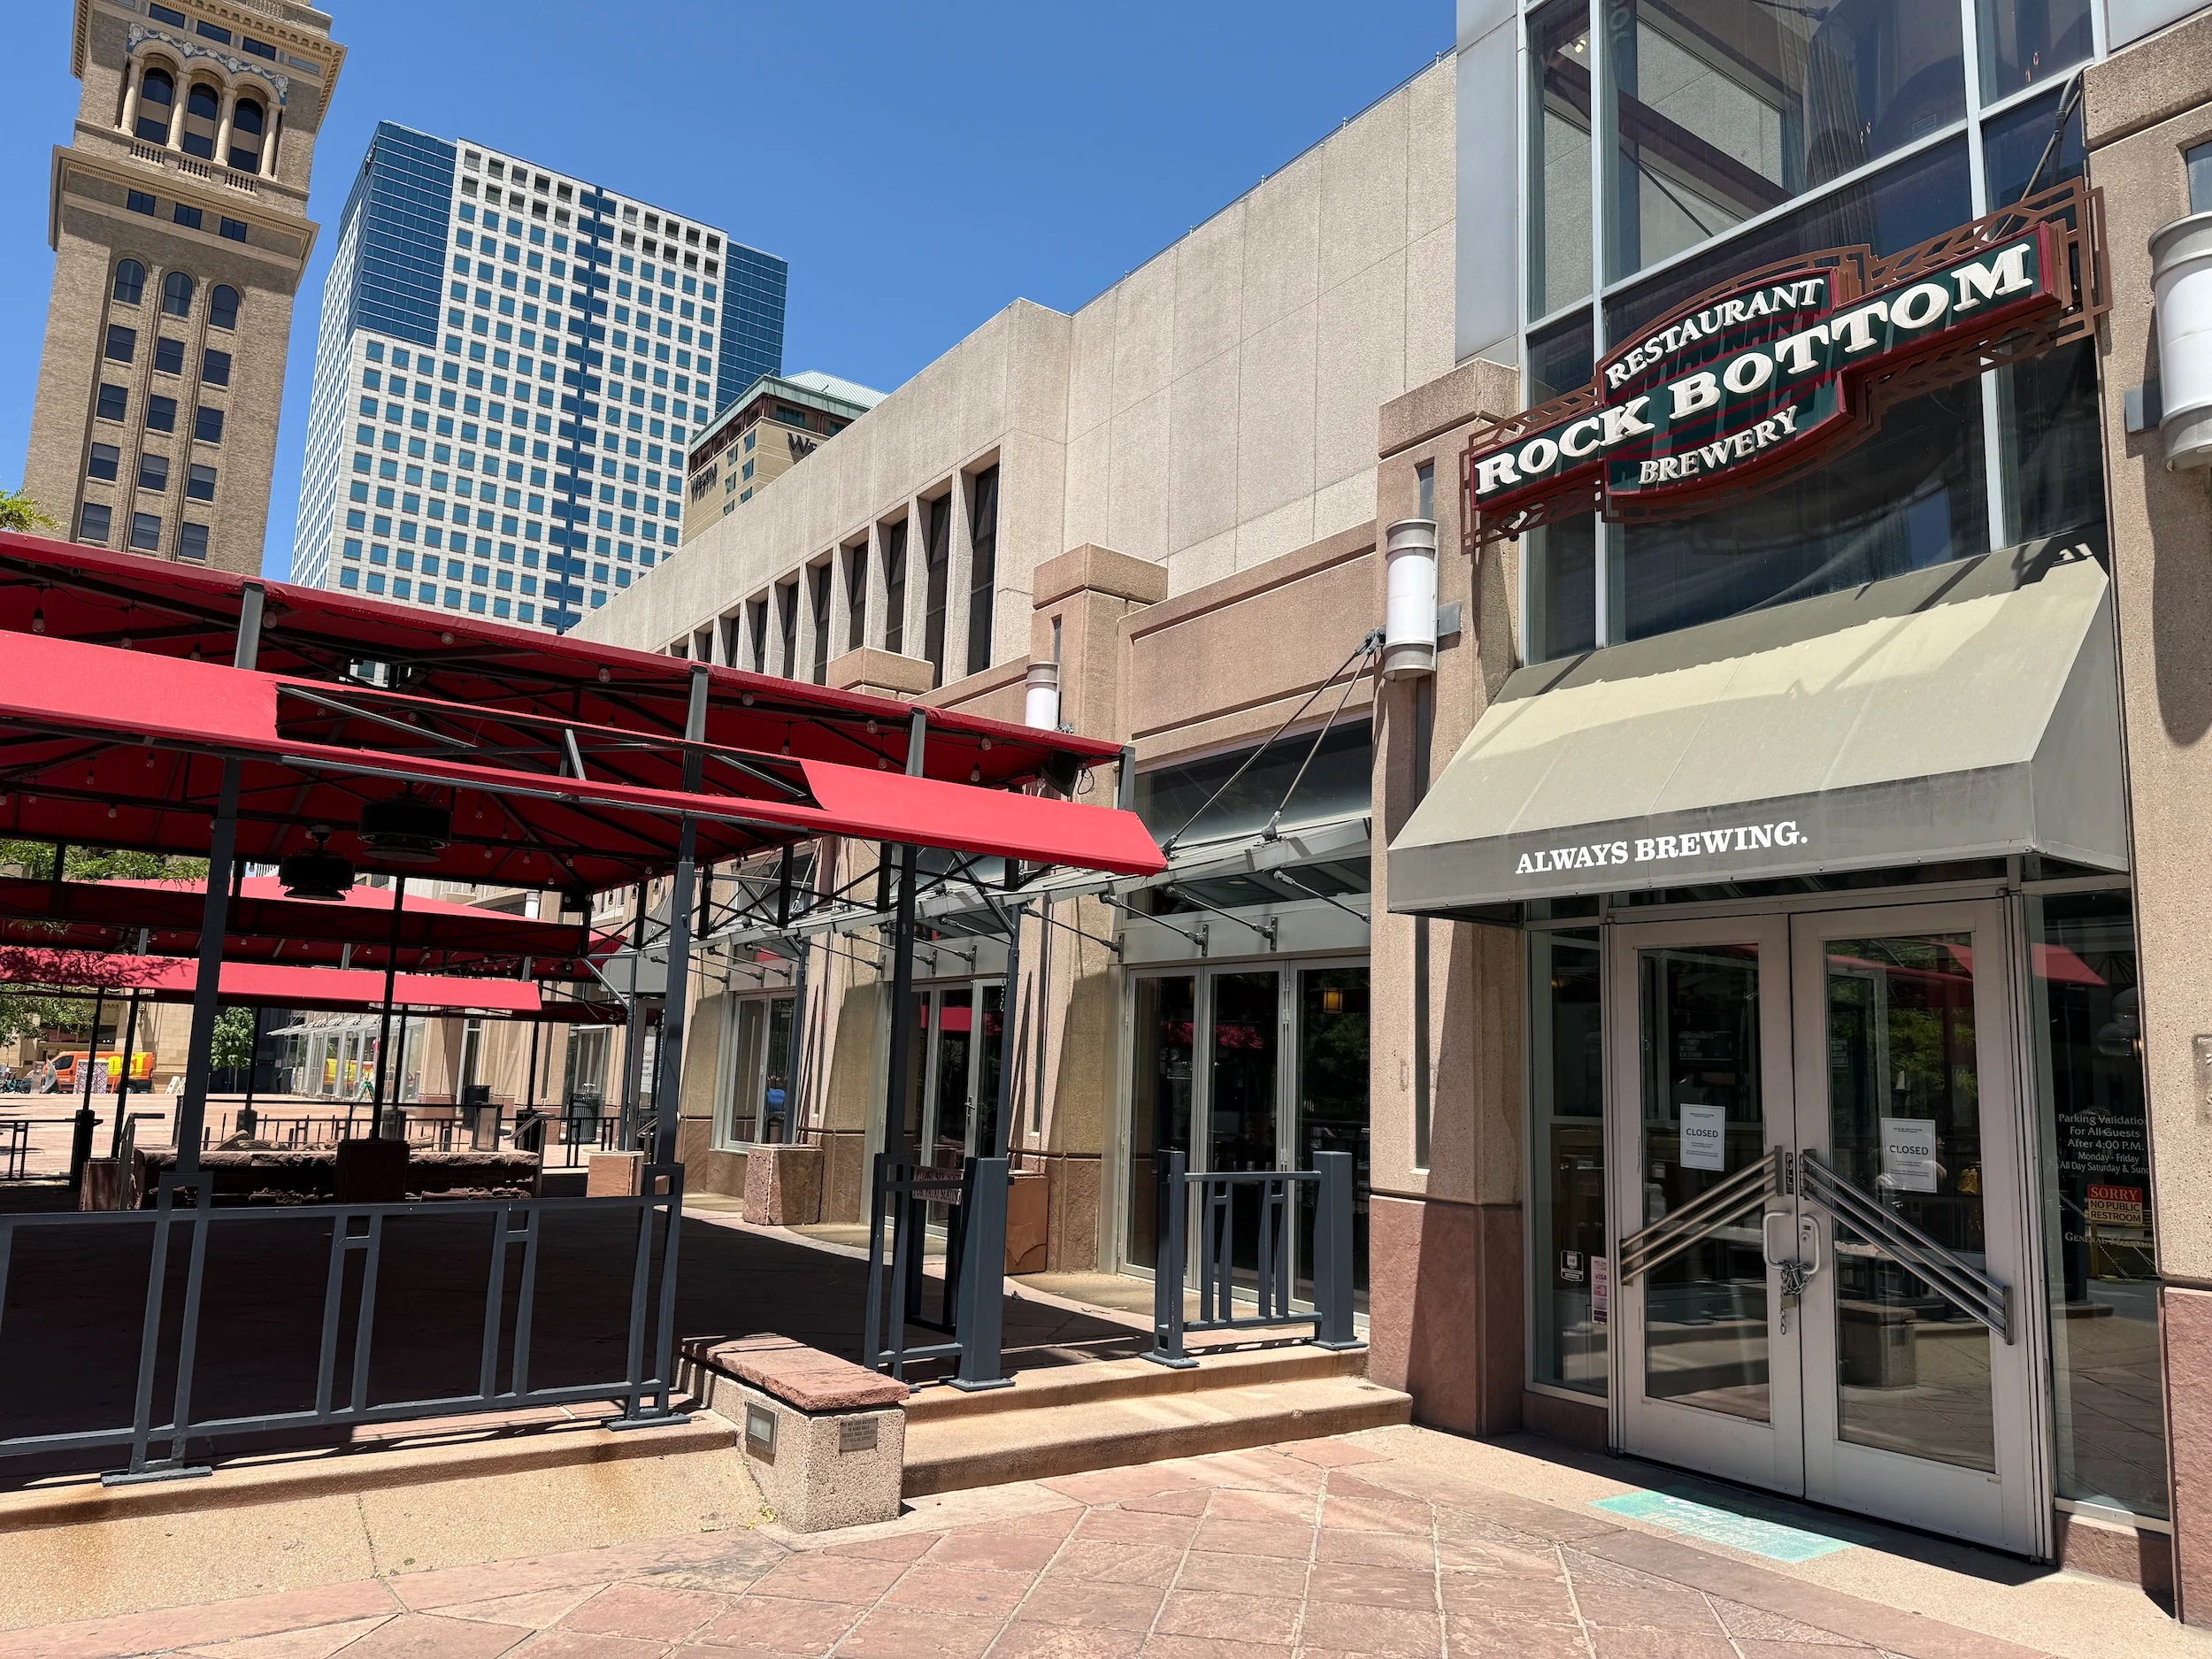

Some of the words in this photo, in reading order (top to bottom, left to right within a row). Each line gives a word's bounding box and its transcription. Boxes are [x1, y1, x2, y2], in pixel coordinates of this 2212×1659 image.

[1606, 278, 1824, 390] RESTAURANT
[1474, 396, 1655, 495] ROCK
[1668, 242, 2034, 420] BOTTOM
[1638, 405, 1799, 486] BREWERY
[1515, 841, 1629, 874] ALWAYS
[1634, 820, 1809, 863] BREWING.
[2058, 1113, 2097, 1126] Parking
[2098, 1115, 2147, 1125] Validatio
[1686, 1127, 1719, 1138] CLOSED
[2070, 1126, 2085, 1136] For
[2087, 1127, 2101, 1137] All
[2103, 1128, 2141, 1138] Guests
[1889, 1145, 1929, 1156] CLOSED
[2067, 1138, 2093, 1148] After
[2095, 1140, 2120, 1149] 4:00
[2122, 1141, 2145, 1151] P.M.
[2078, 1152, 2110, 1164] Monday
[2116, 1153, 2139, 1165] Friday
[2060, 1162, 2070, 1171] All
[2071, 1162, 2086, 1172] Day
[2087, 1163, 2121, 1174] Saturday
[2123, 1164, 2129, 1173] &
[2091, 1187, 2139, 1201] SORRY
[2090, 1200, 2105, 1210] NO
[2106, 1200, 2140, 1212] PUBLIC
[2090, 1210, 2141, 1223] RESTROOM
